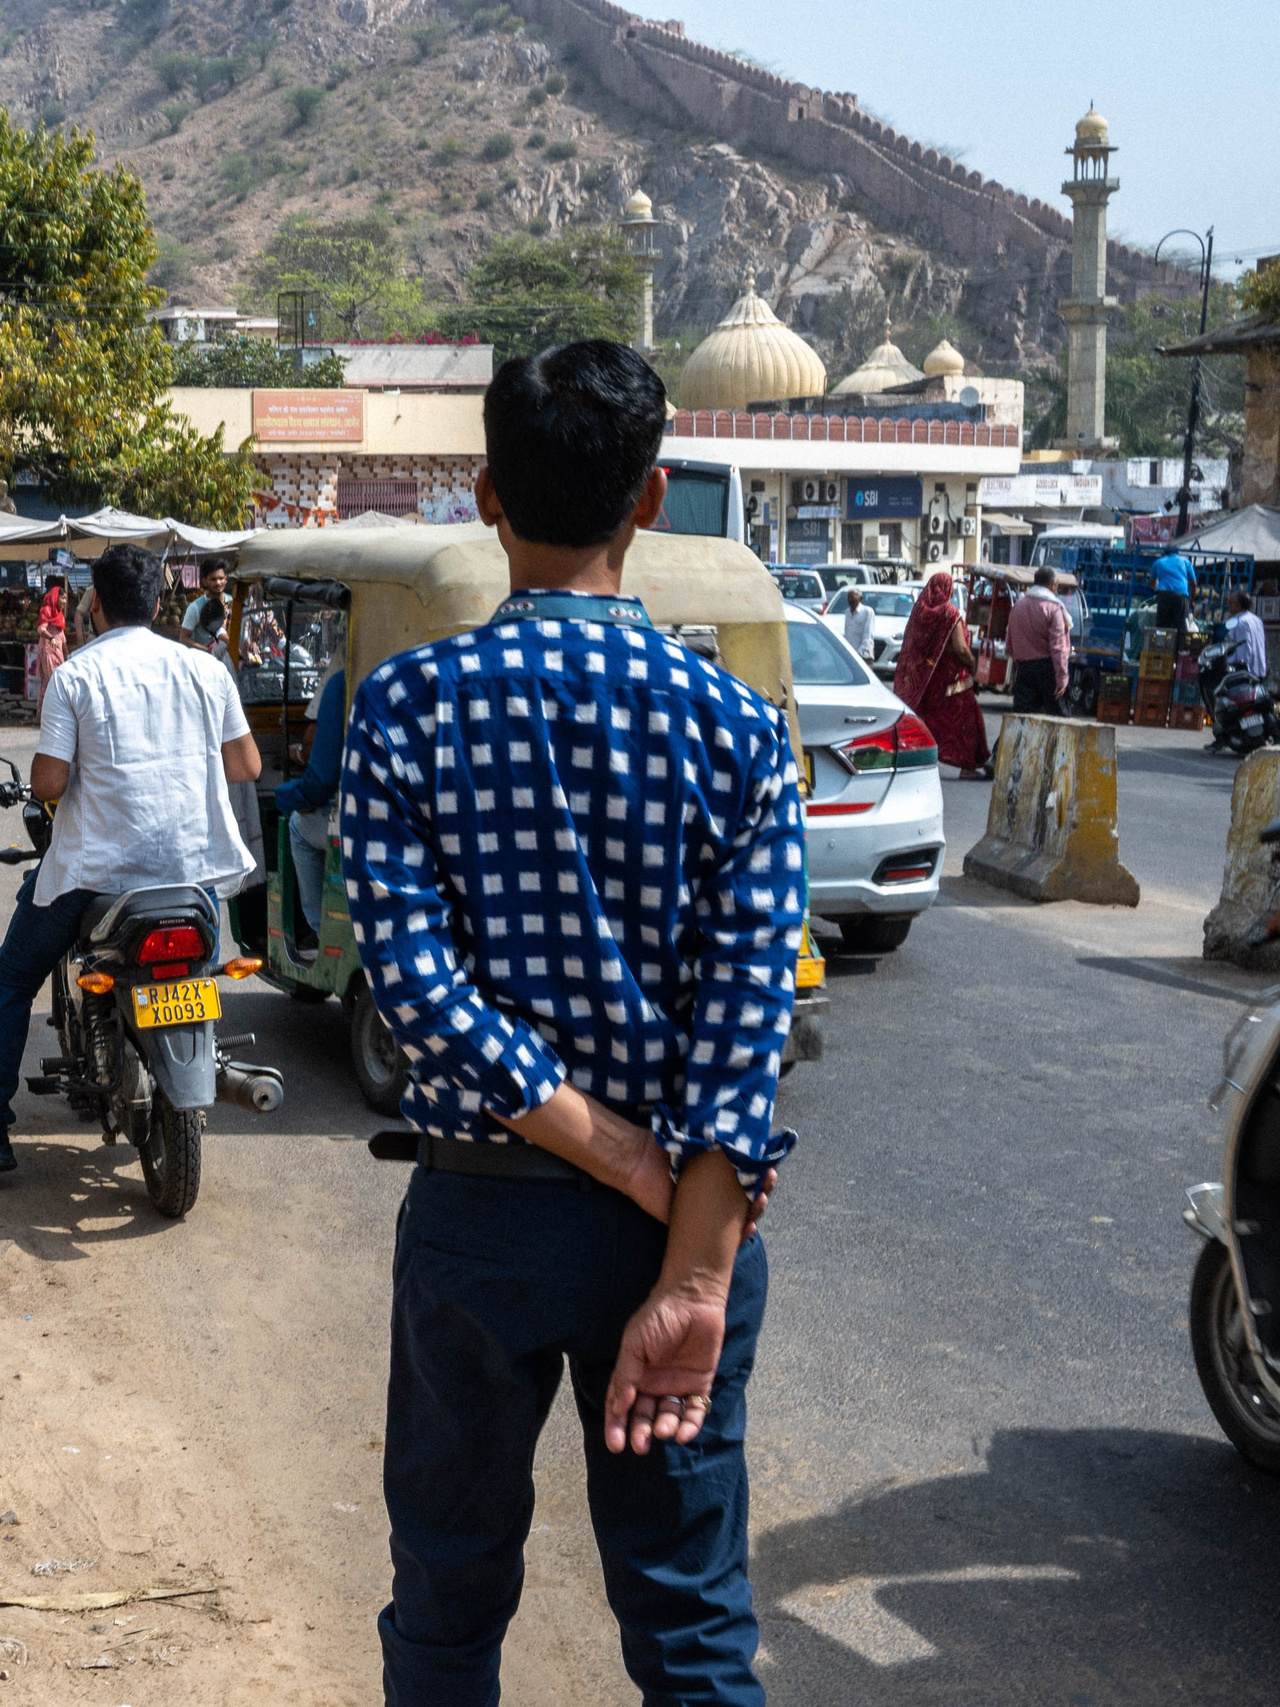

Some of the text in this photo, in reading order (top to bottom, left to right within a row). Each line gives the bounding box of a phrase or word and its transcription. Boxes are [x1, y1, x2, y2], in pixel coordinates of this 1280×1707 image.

[864, 490, 878, 506] SBI
[803, 522, 820, 537] SBI
[149, 983, 202, 1006] RJ42X
[152, 1002, 205, 1024] X0093
